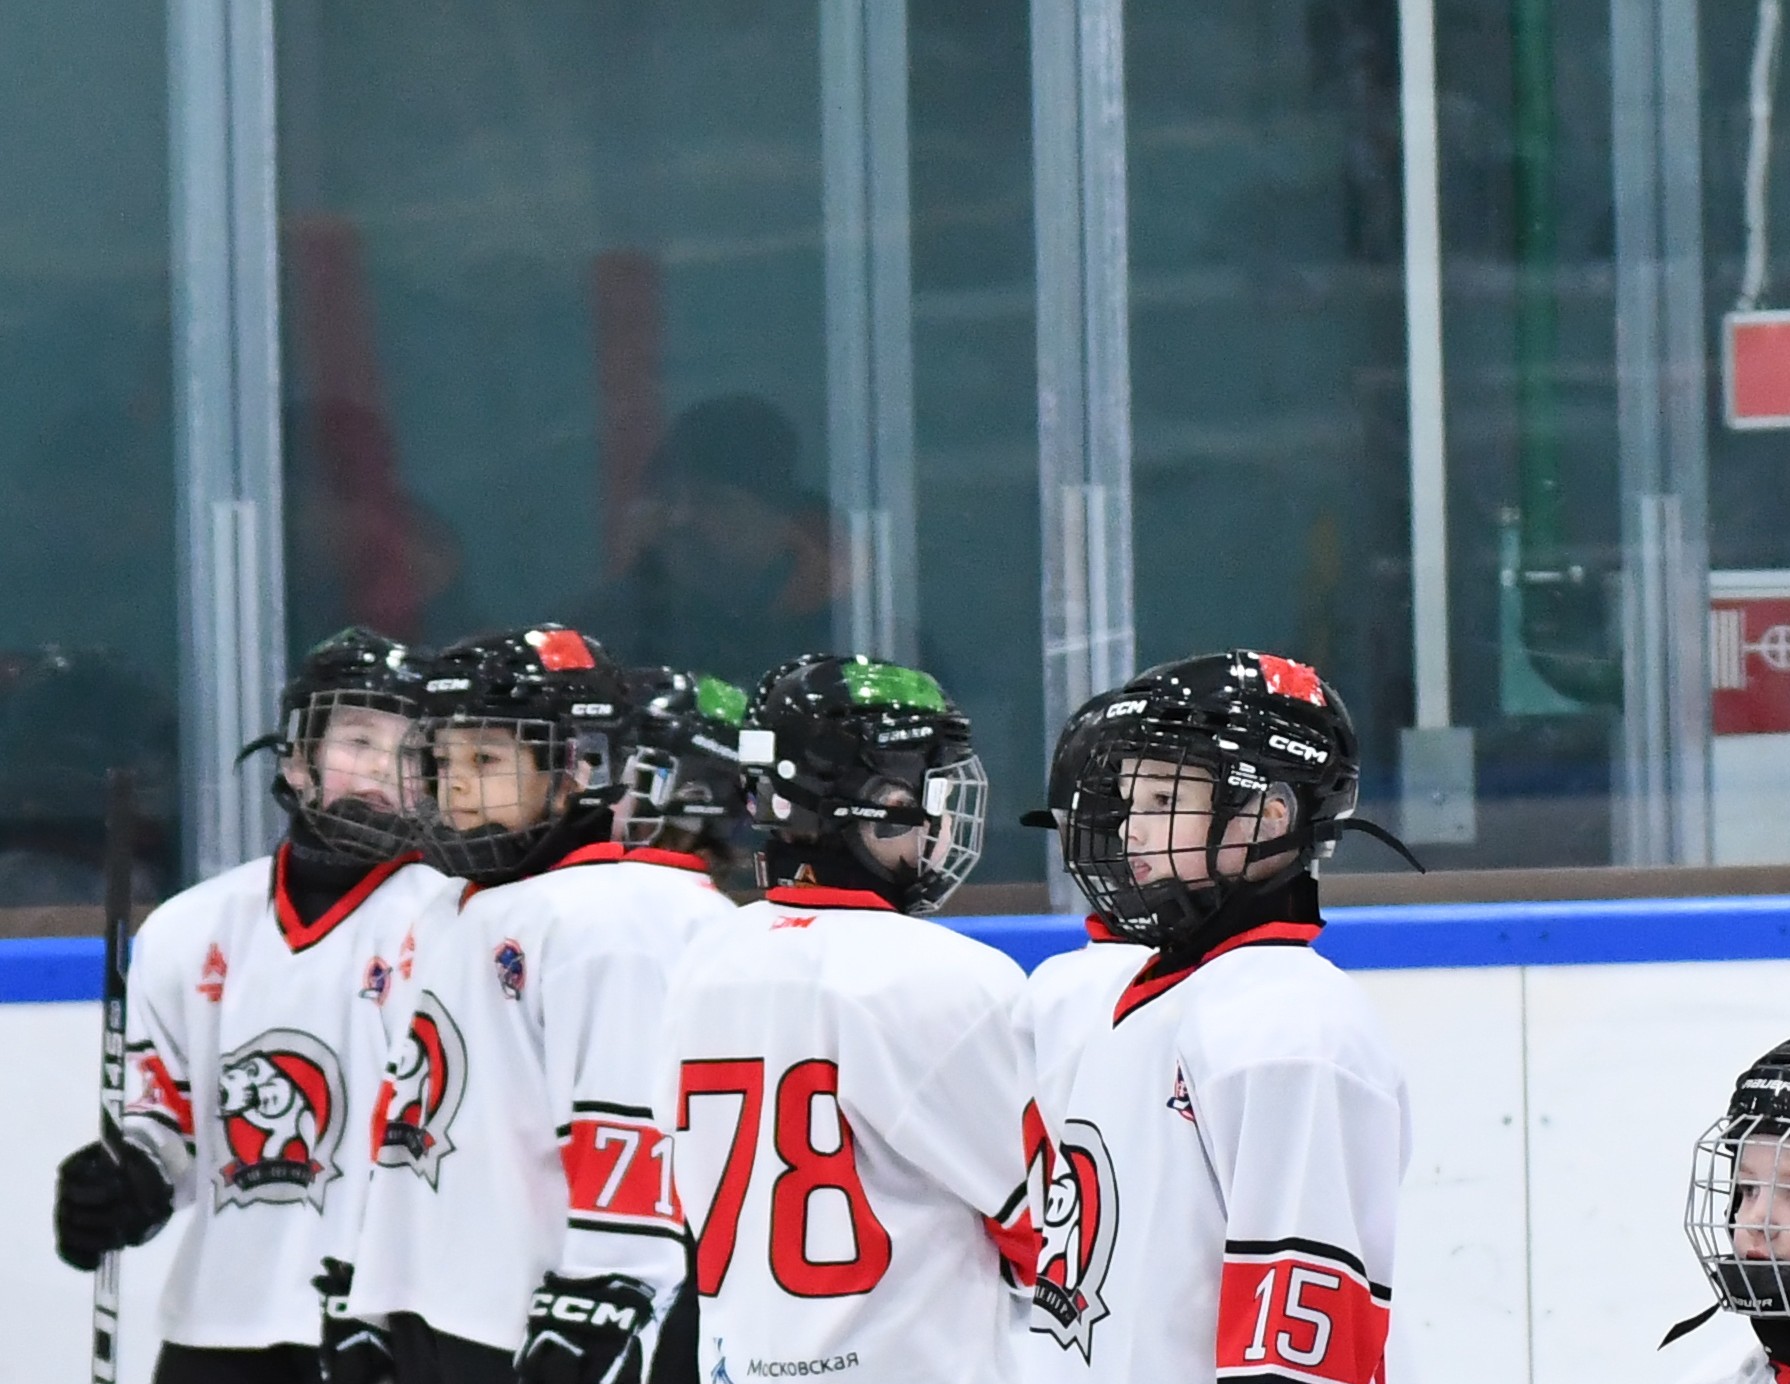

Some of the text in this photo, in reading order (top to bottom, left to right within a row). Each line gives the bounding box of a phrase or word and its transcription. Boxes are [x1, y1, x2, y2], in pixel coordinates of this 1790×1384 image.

[1106, 700, 1147, 719] CCM
[1269, 735, 1328, 763] CCM
[594, 1126, 677, 1217] 71
[676, 1058, 893, 1298] 78
[529, 1293, 636, 1331] CCM
[1244, 1266, 1342, 1367] 15
[747, 1352, 860, 1377] Московская
